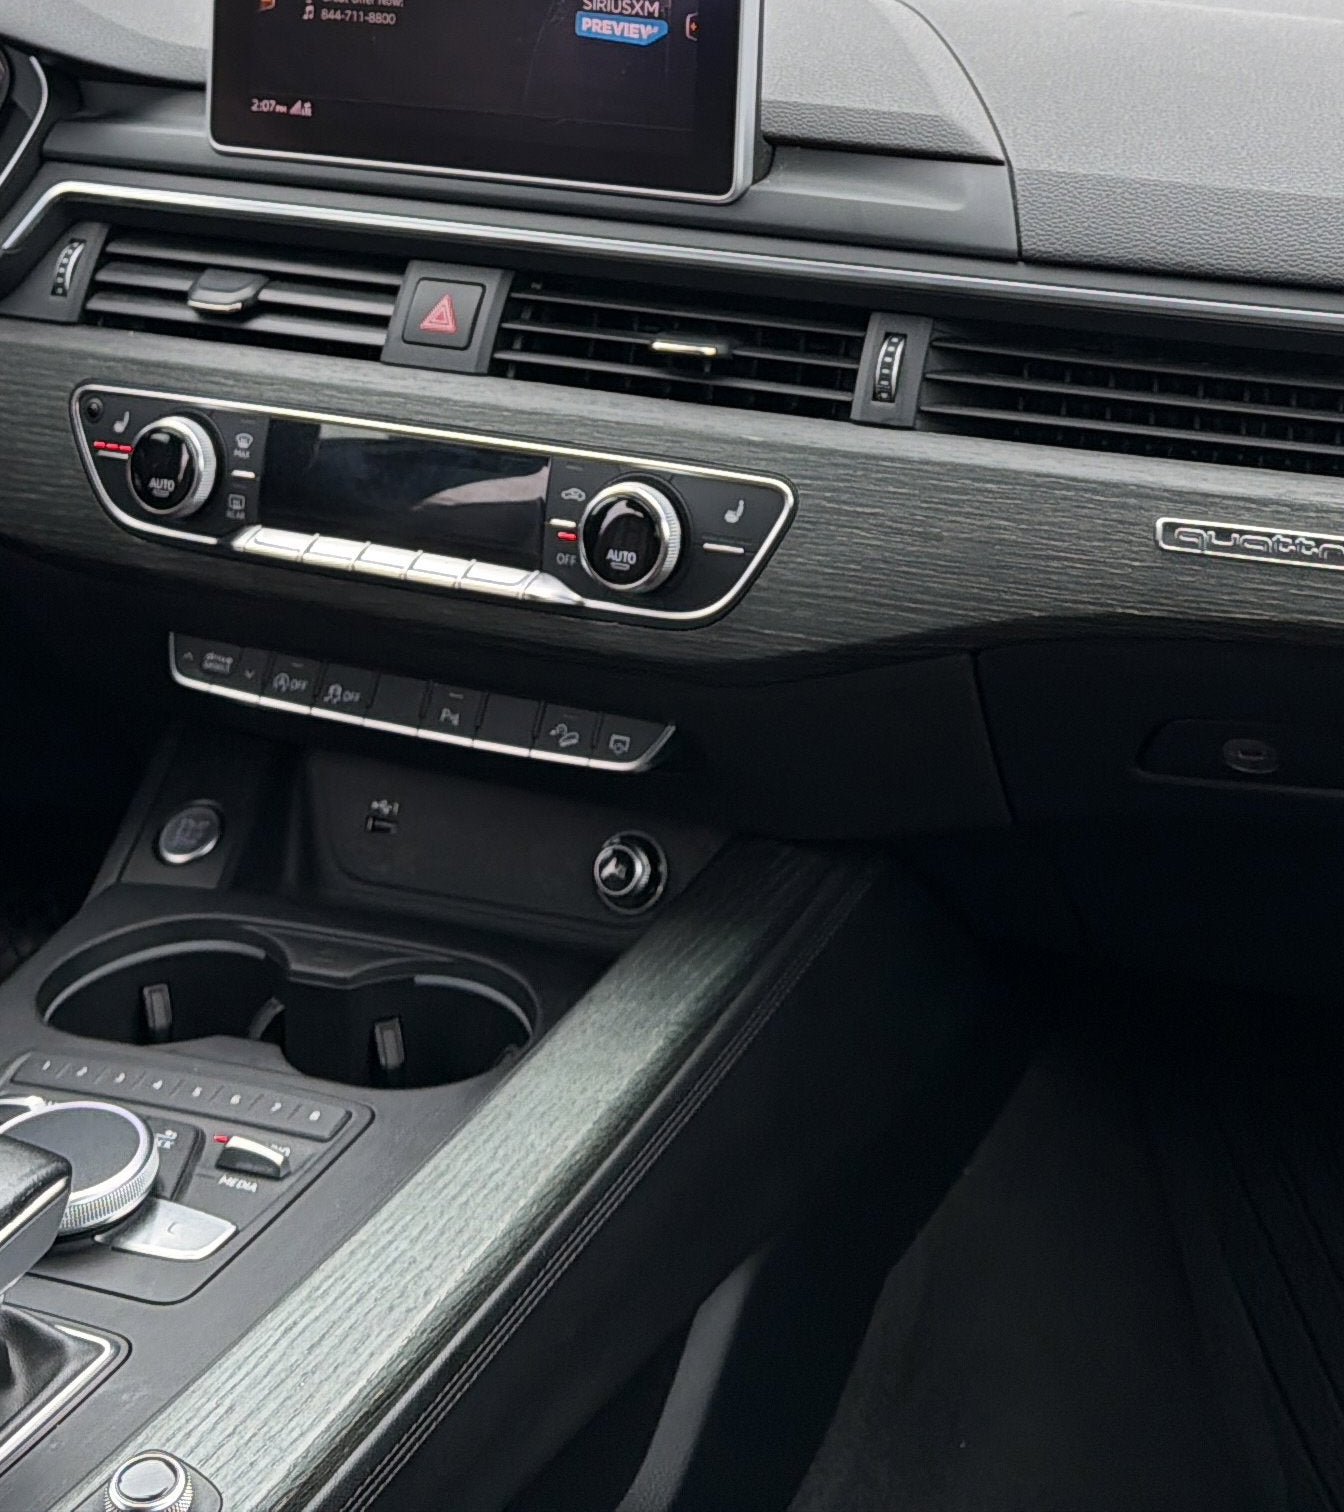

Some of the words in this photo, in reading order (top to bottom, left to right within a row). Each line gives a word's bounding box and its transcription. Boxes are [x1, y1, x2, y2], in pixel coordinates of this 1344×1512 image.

[320, 8, 397, 26] 844-711-8800
[581, 17, 660, 41] PREVIEW
[148, 477, 176, 491] AUTO
[556, 551, 577, 566] OFF
[605, 548, 638, 564] AUTO
[218, 1174, 259, 1193] MEDIA
